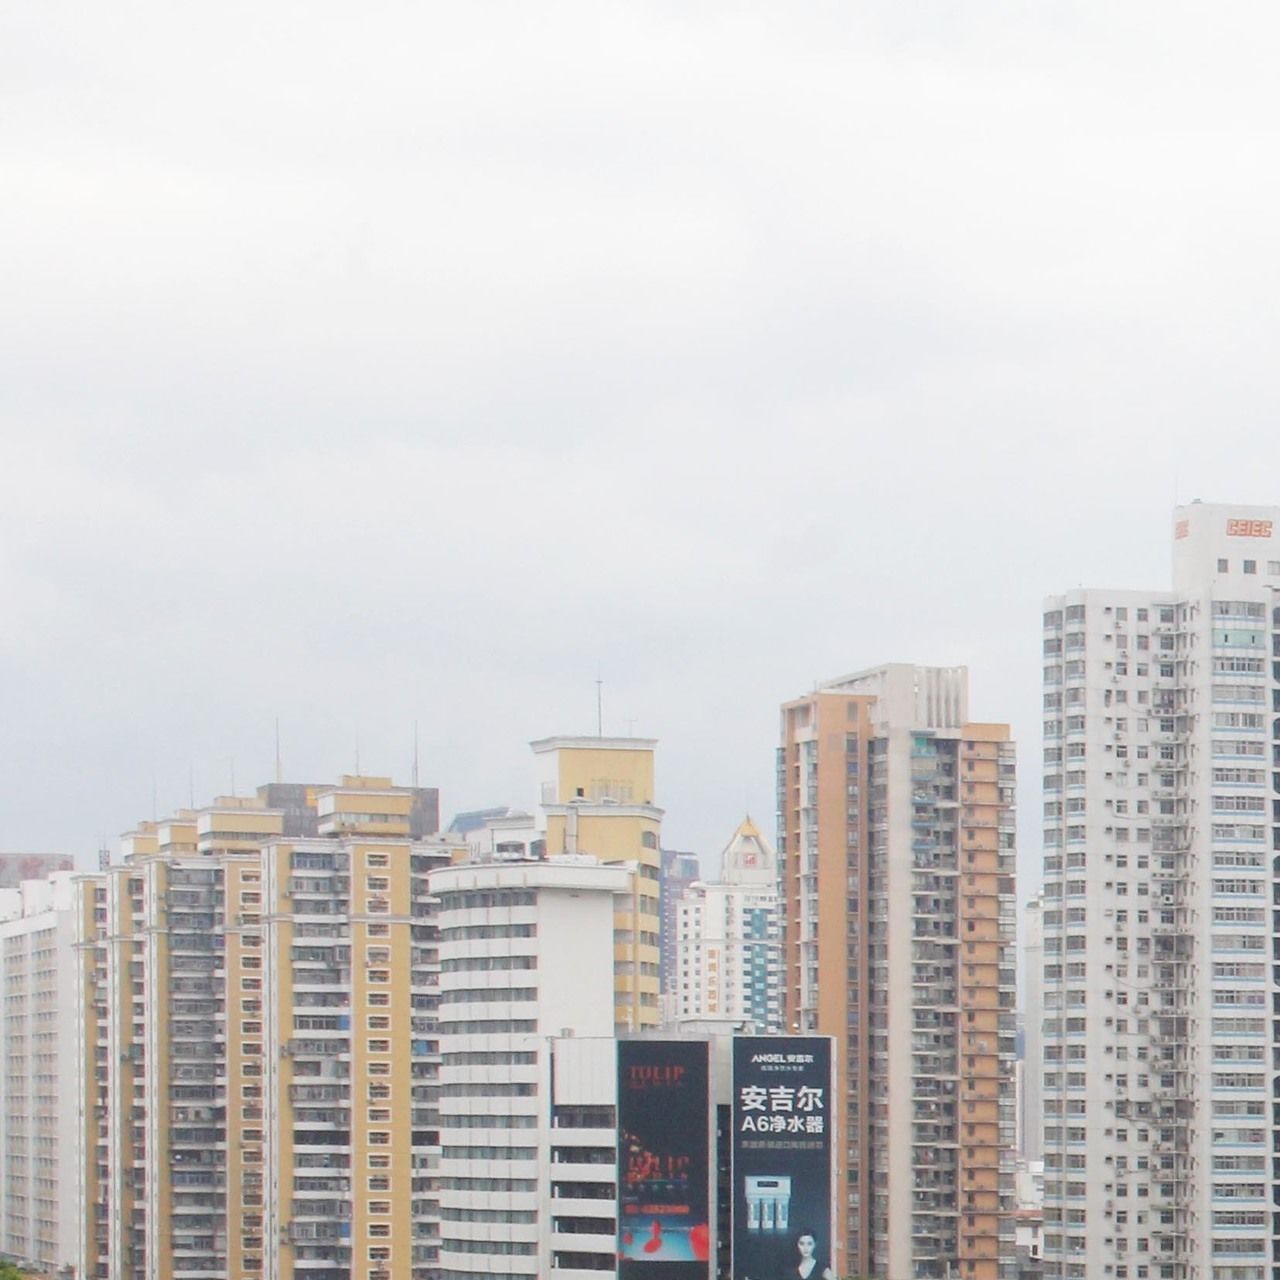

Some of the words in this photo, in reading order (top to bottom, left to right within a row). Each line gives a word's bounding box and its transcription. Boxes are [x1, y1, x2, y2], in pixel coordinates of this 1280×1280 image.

[752, 1054, 786, 1063] ANGEL
[741, 1085, 824, 1112] 安吉尔
[741, 1115, 824, 1133] A6净水器
